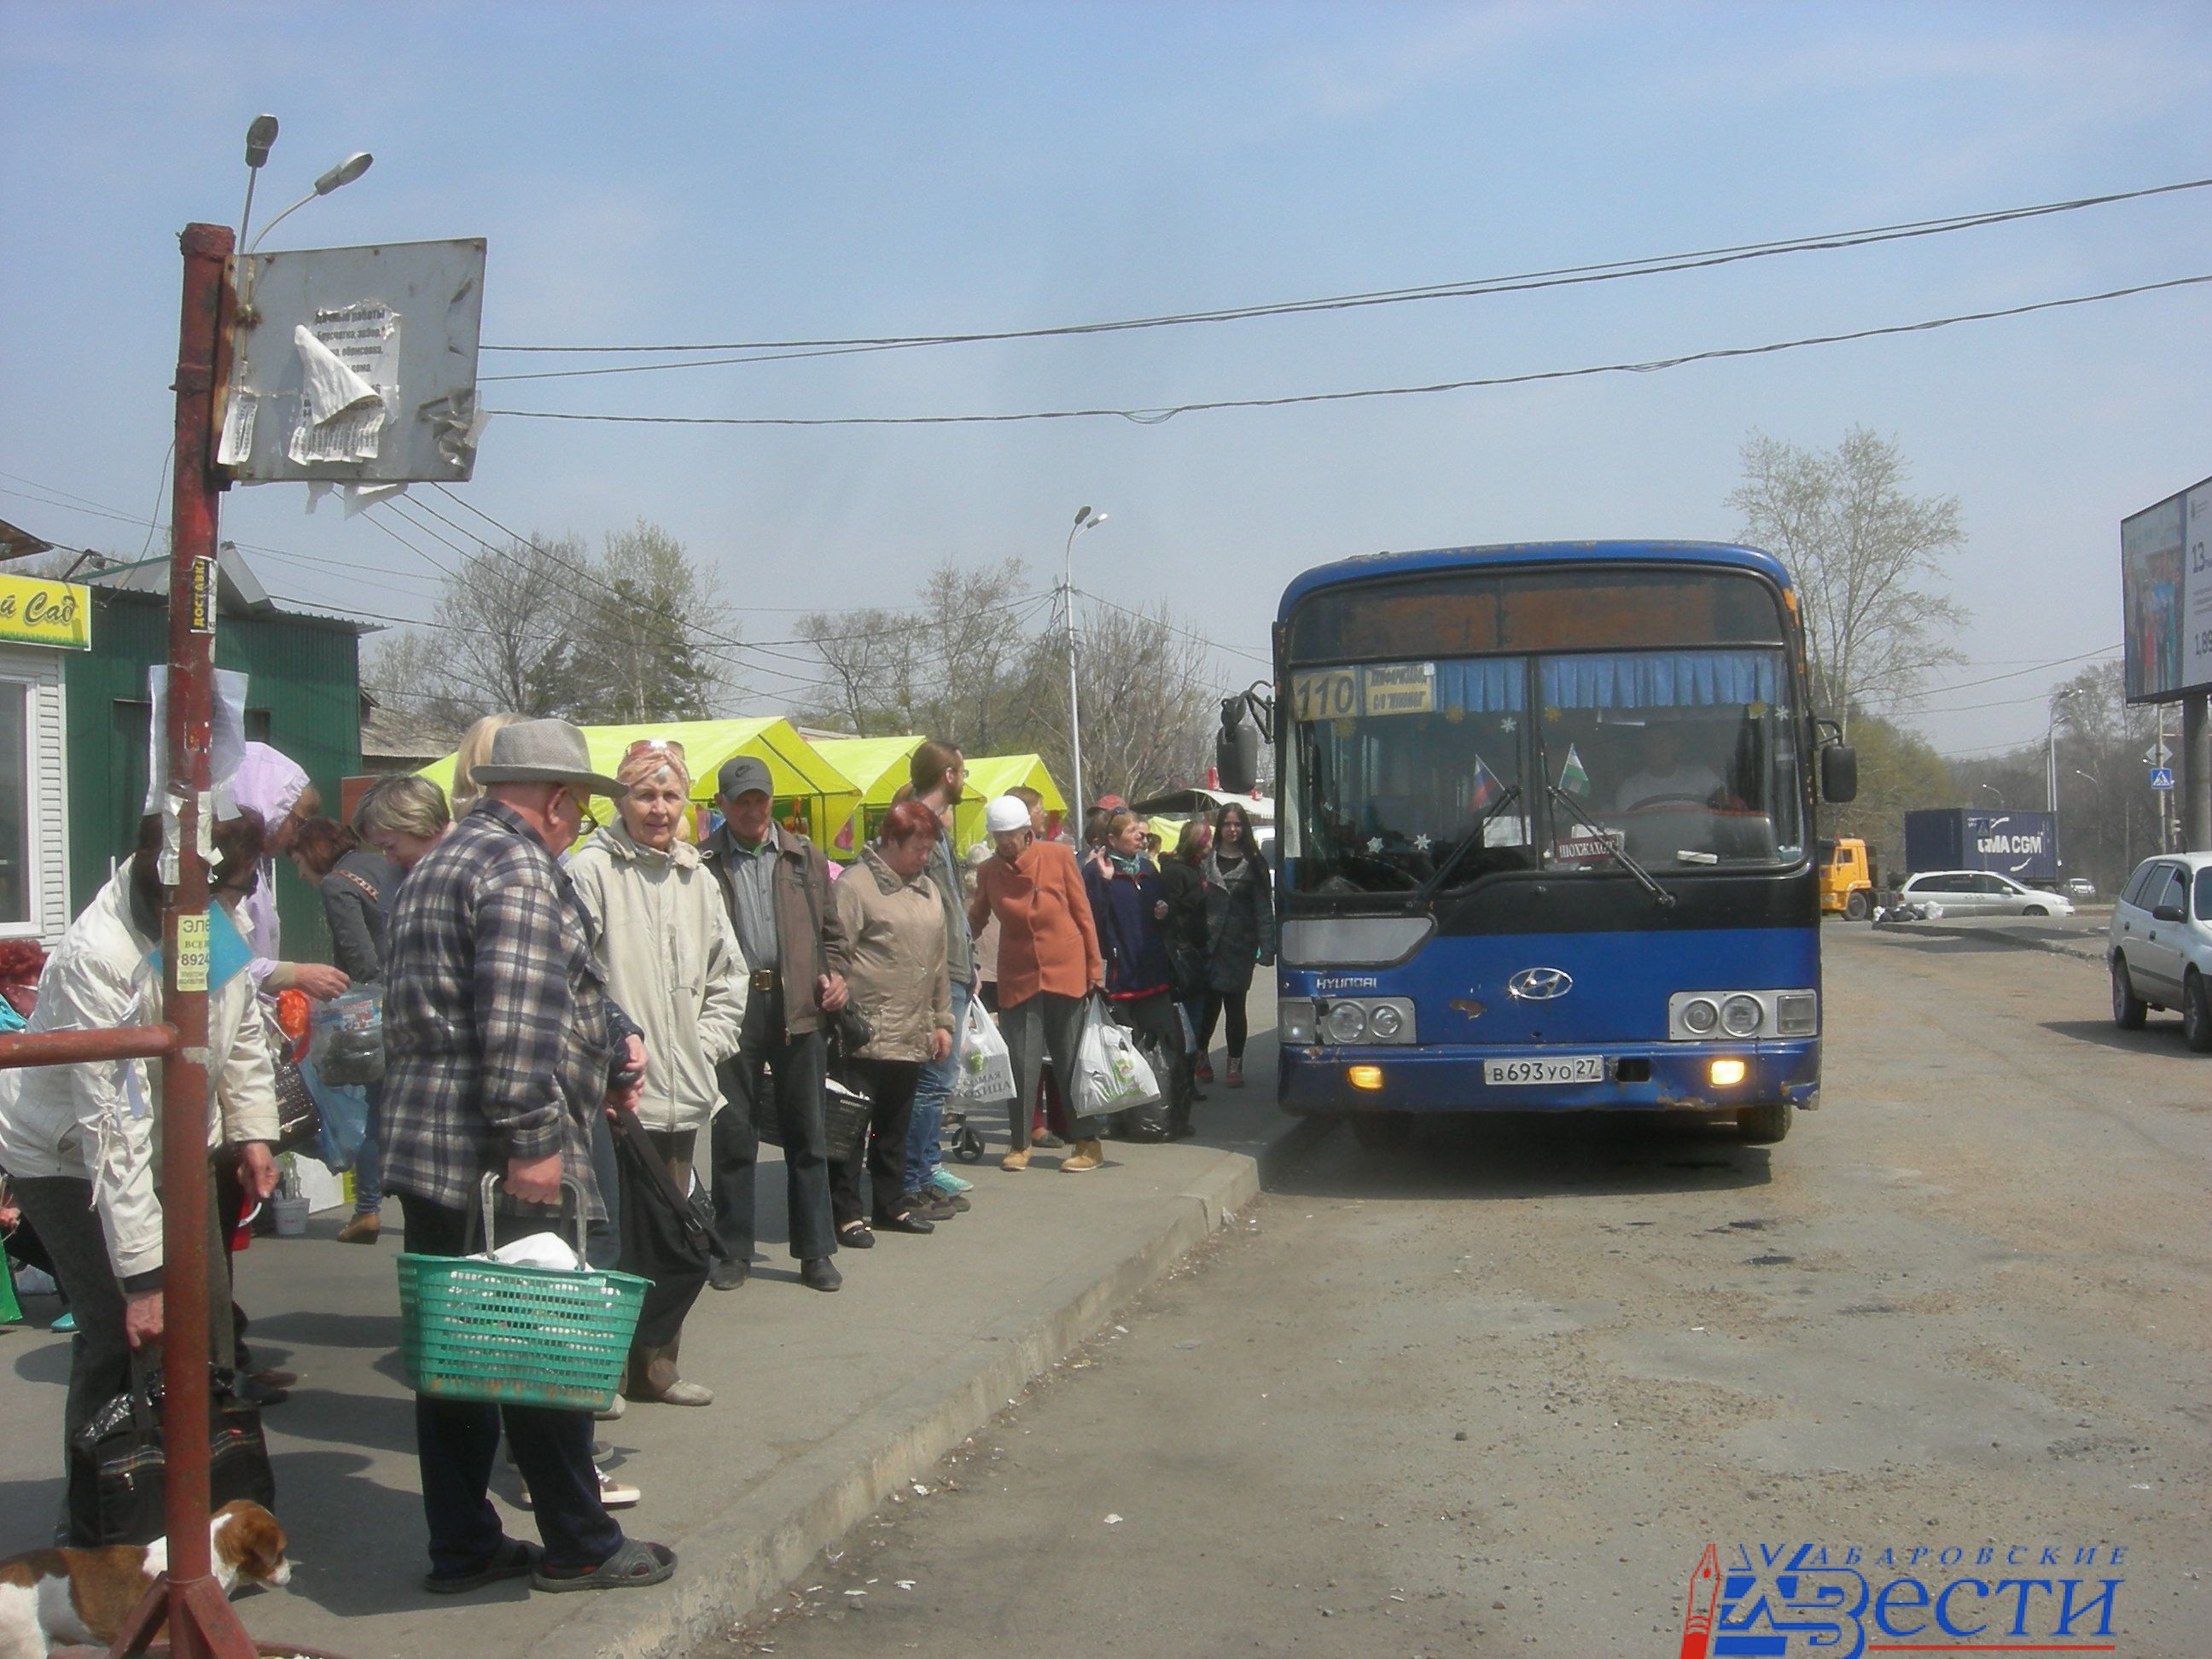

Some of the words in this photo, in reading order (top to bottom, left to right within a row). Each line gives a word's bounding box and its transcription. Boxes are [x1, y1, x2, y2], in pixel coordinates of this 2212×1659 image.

[25, 591, 76, 623] Сад
[1296, 676, 1354, 717] 110
[2011, 835, 2041, 853] CGM
[1317, 977, 1377, 989] HYUNDAI
